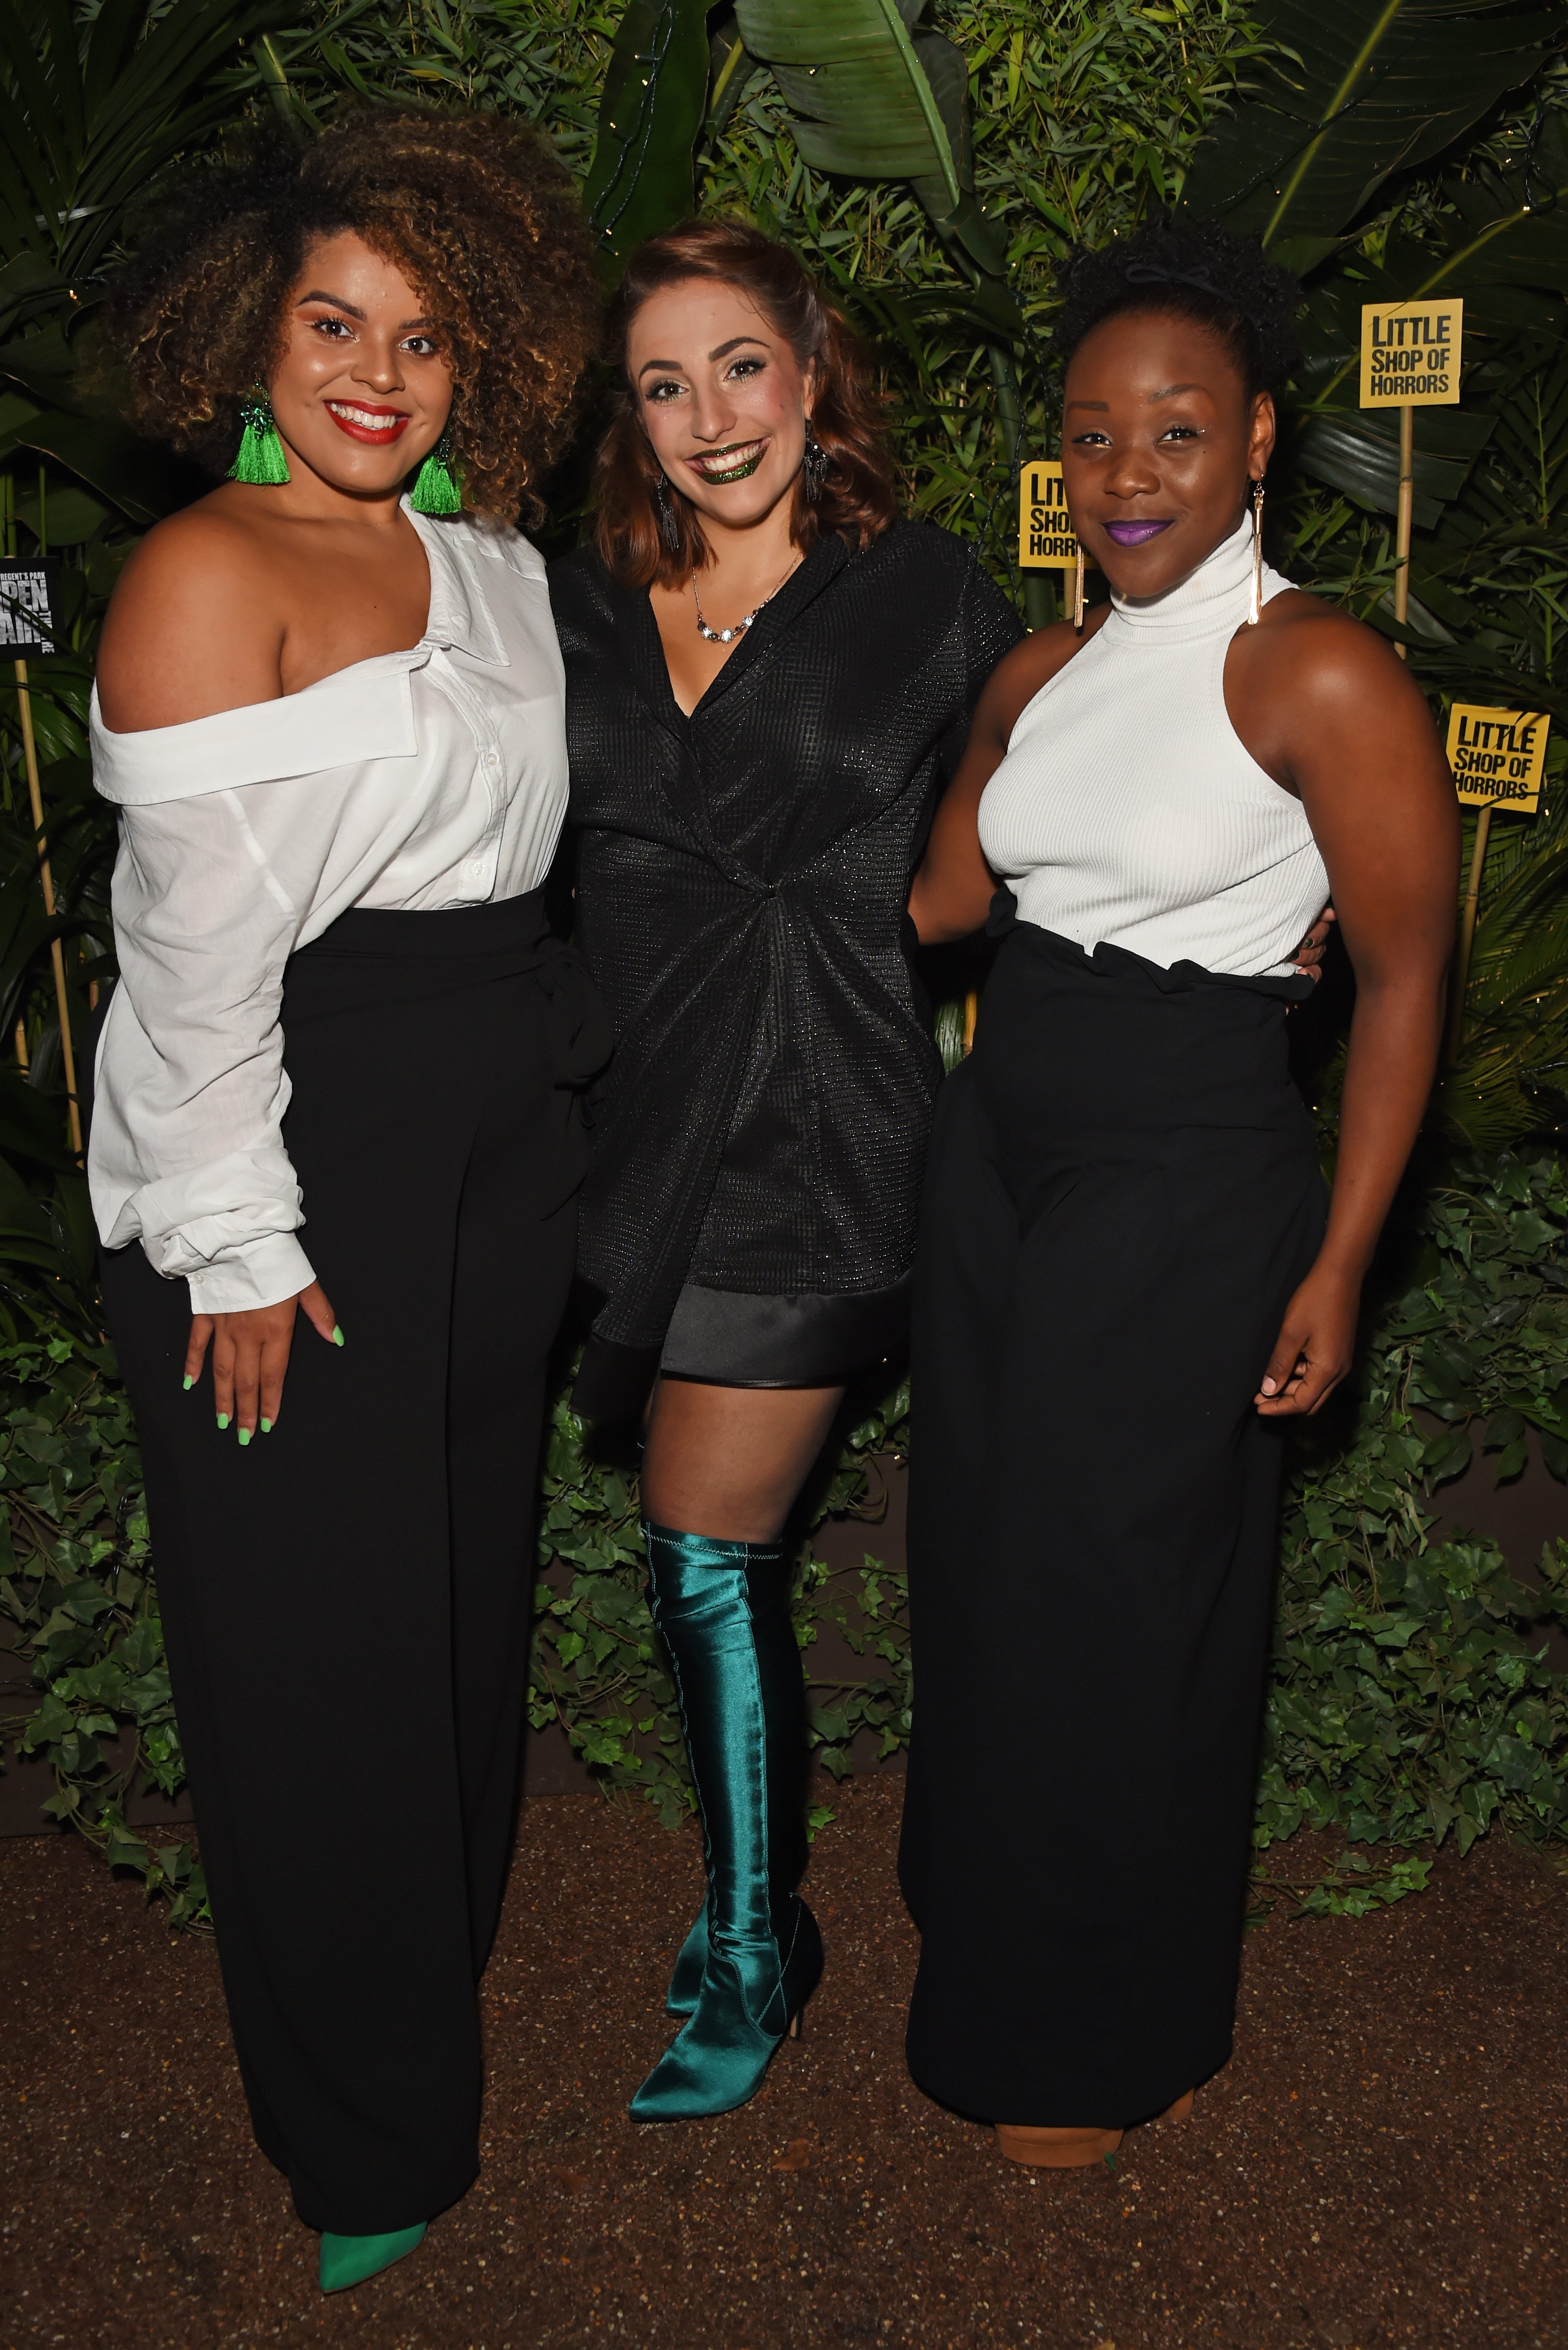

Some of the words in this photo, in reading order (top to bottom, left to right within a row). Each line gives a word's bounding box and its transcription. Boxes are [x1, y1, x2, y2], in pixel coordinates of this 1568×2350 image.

[1372, 315, 1451, 347] LITTLE
[1371, 349, 1423, 373] SHOP
[1428, 348, 1450, 370] OF
[1371, 374, 1449, 396] HORRORS
[1031, 474, 1064, 506] LIT
[1030, 508, 1076, 533] SHO
[1030, 534, 1077, 557] HORR
[0, 572, 29, 581] REGENT'S
[0, 580, 49, 613] PEN
[1458, 716, 1537, 754] LITTLE
[1454, 748, 1506, 775] SHOP
[1509, 757, 1532, 778] OF
[1453, 771, 1528, 800] HORRORS
